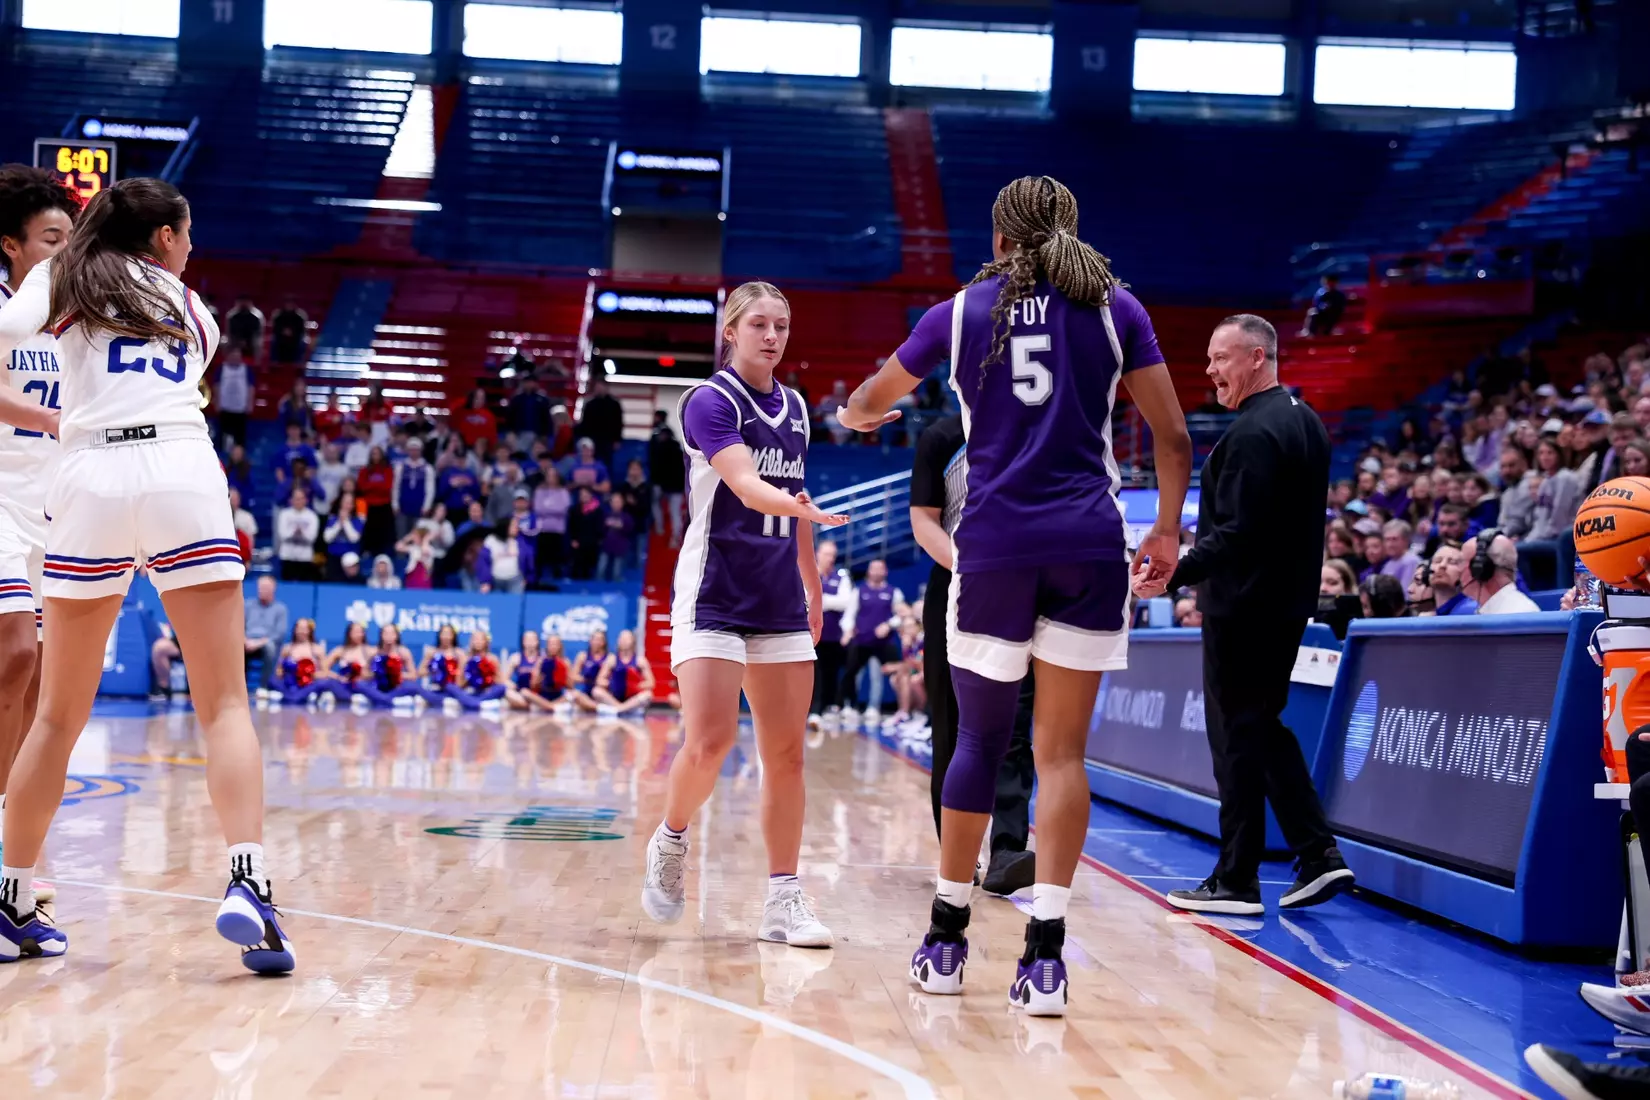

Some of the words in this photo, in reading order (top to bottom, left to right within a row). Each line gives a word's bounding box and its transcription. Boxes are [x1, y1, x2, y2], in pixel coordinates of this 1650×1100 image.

[650, 25, 676, 49] 12
[57, 147, 109, 174] 6:07
[1010, 295, 1050, 326] FOY
[6, 349, 60, 373] JAYHA
[1010, 334, 1054, 407] 5
[746, 445, 805, 480] Wildcats
[1575, 514, 1616, 540] NCAA
[397, 607, 490, 633] Kansas
[1373, 706, 1448, 770] KONICA
[1445, 713, 1548, 786] MINOLTA
